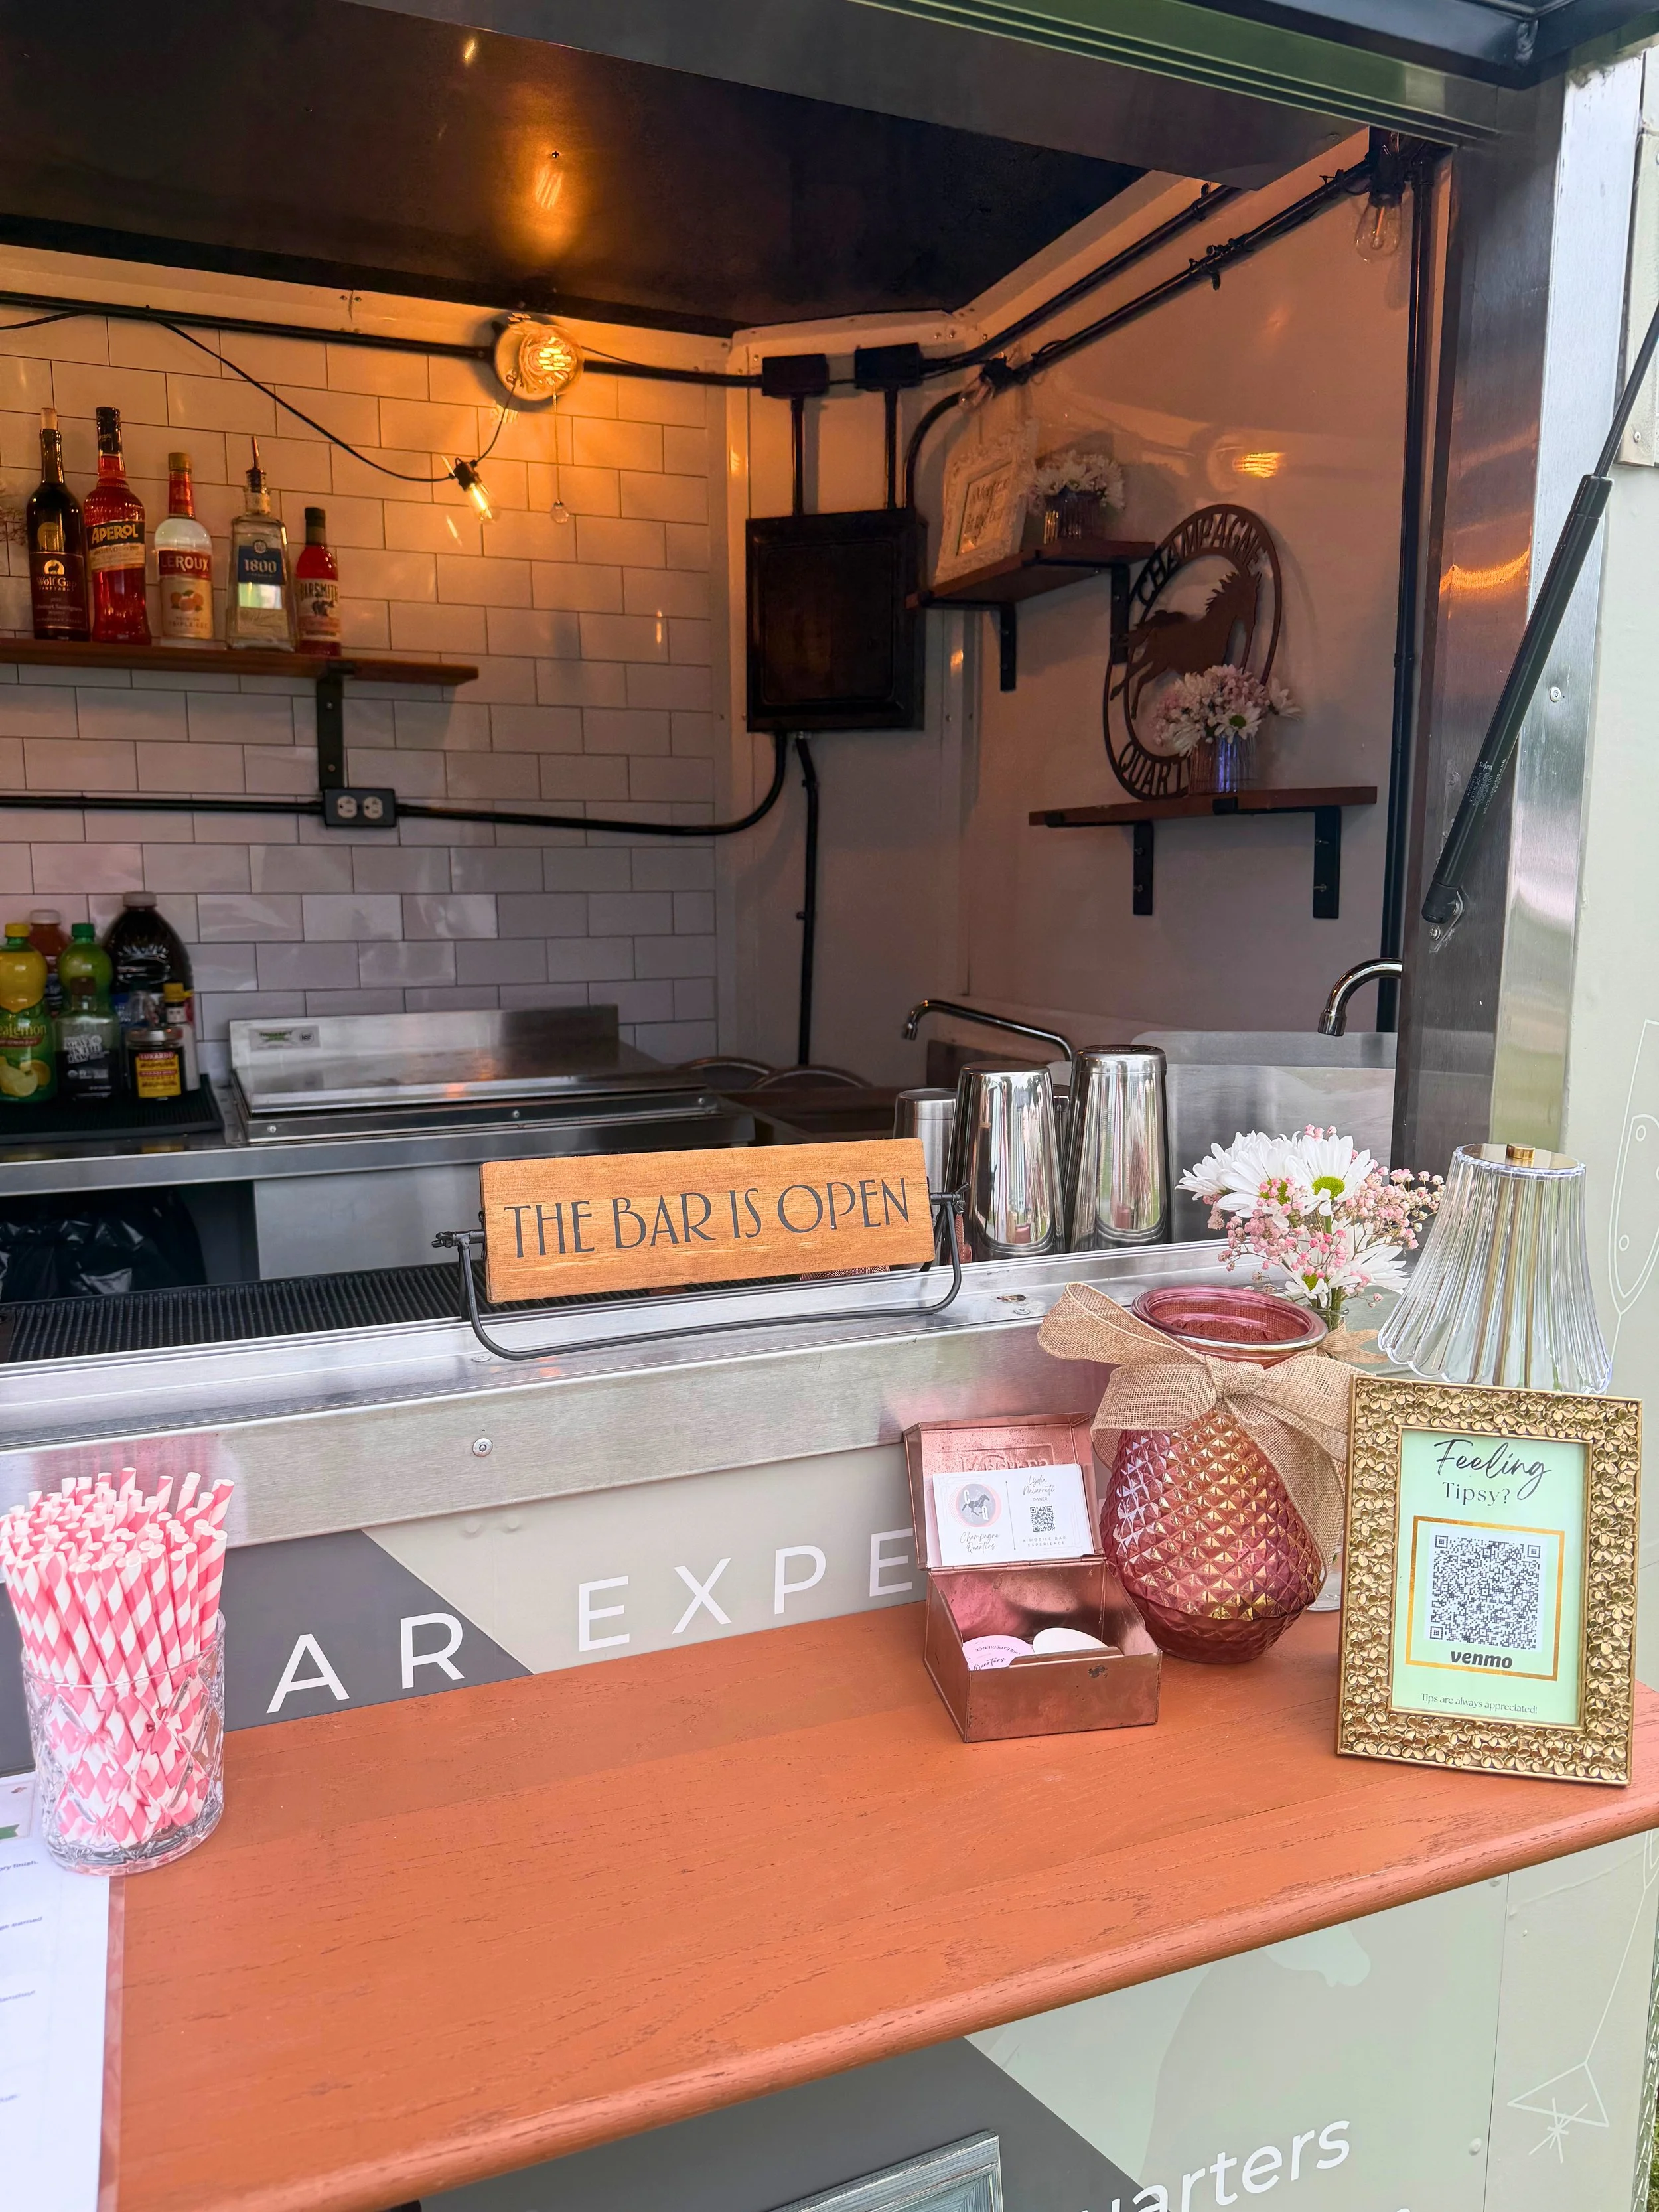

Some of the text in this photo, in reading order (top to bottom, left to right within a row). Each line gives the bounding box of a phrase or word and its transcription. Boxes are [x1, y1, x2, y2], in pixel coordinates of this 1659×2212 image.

[92, 524, 139, 544] APEROL
[161, 555, 209, 572] LEROUX
[244, 559, 277, 573] 1800
[1137, 512, 1267, 605] CHAMPAGNE
[36, 575, 55, 587] Wolf
[1118, 741, 1191, 796] QUART
[504, 1177, 910, 1259] THE BAR IS OPEN
[1433, 1438, 1552, 1501] Feeling
[1442, 1481, 1511, 1507] Tipsy?
[960, 1532, 1000, 1544] Champagne
[579, 1527, 914, 1652] EXPE
[1450, 1650, 1514, 1670] venmo
[1420, 1693, 1439, 1704] Tips
[1455, 1696, 1483, 1709] always
[1484, 1700, 1538, 1714] appreciated!
